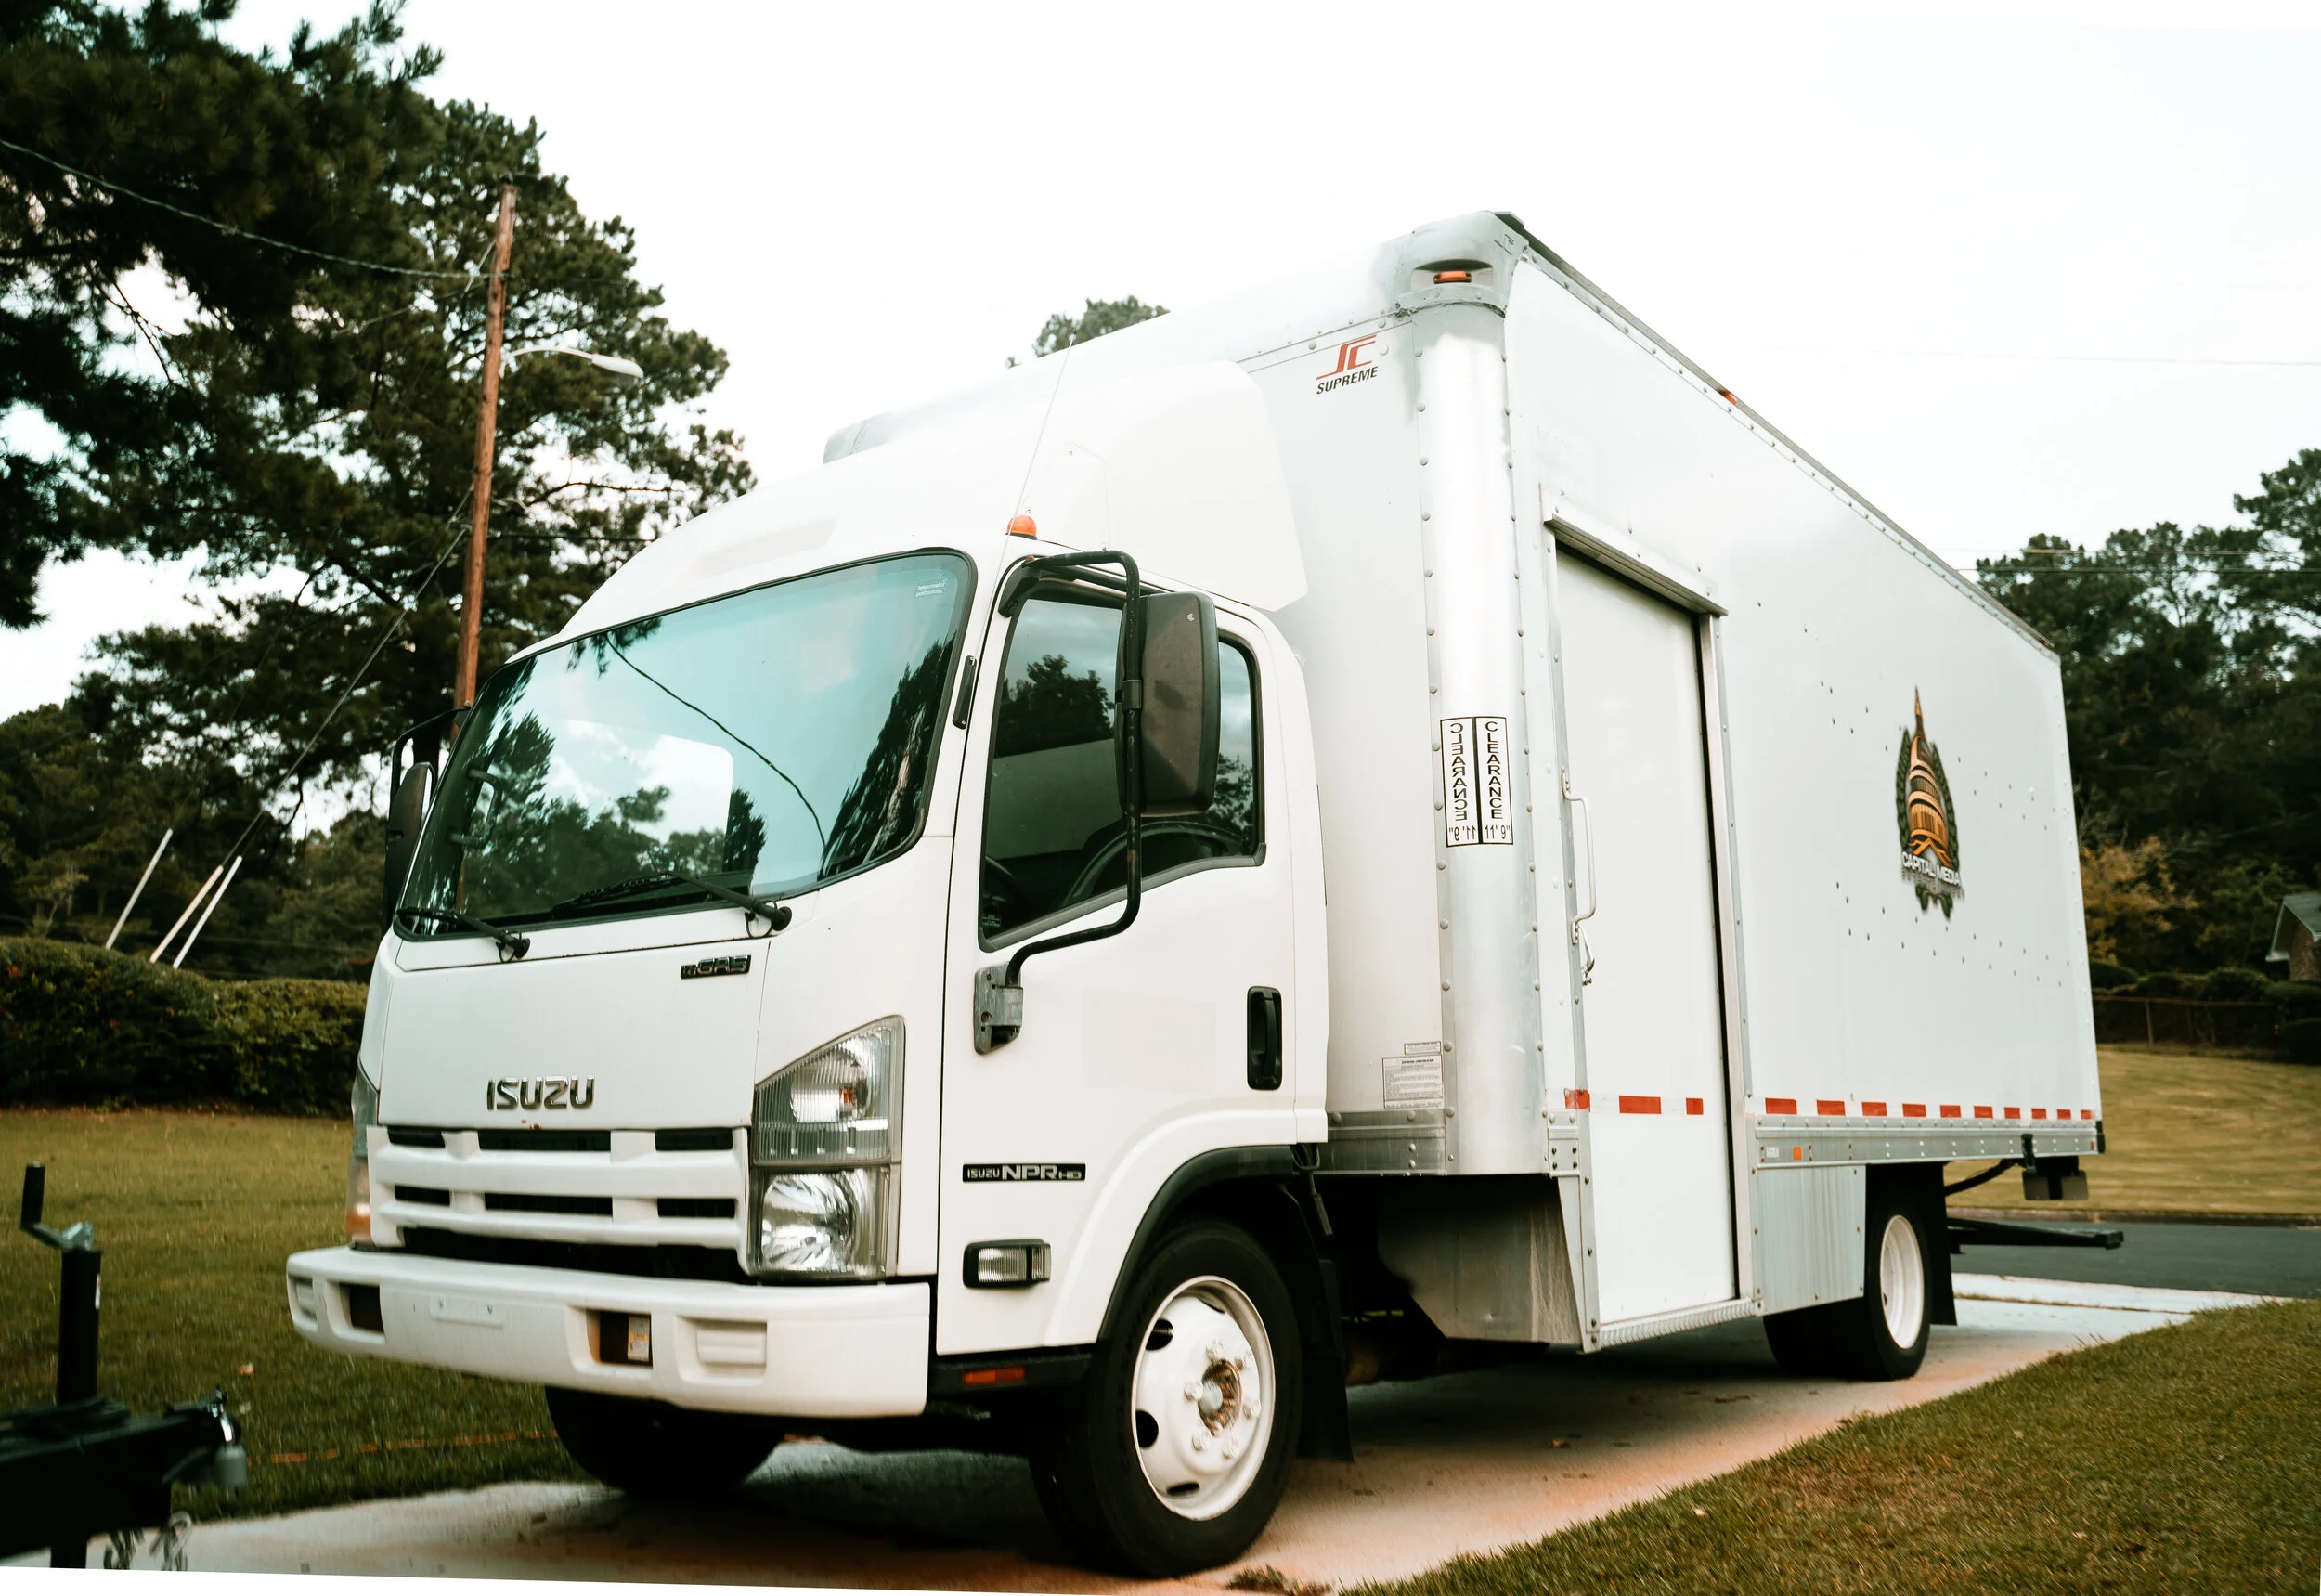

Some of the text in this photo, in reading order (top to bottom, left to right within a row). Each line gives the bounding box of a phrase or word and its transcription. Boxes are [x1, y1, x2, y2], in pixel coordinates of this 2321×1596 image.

[1316, 366, 1379, 395] SUPREME
[1485, 721, 1503, 820] CLEARANCE
[697, 955, 748, 975] GAS
[486, 1075, 594, 1110] ISUZU
[967, 1167, 1000, 1179] ISUZU
[1002, 1165, 1058, 1180] NPR
